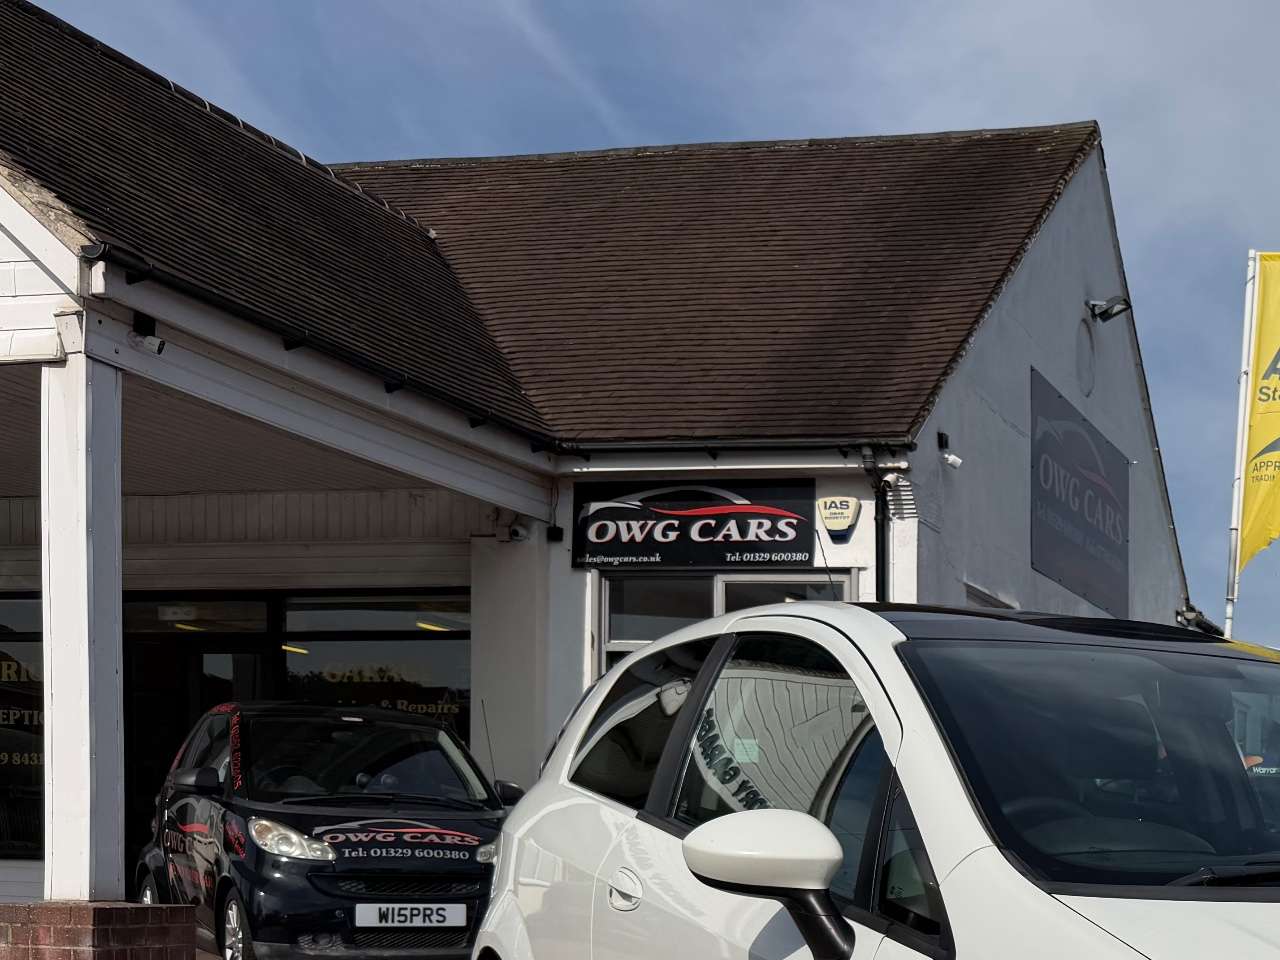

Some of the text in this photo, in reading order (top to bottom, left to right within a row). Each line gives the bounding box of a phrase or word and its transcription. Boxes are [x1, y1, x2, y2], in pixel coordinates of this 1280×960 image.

[824, 500, 850, 511] IAS
[1039, 453, 1079, 511] OWG
[1084, 488, 1123, 545] CARS
[587, 518, 798, 543] OWG CARS
[577, 553, 662, 566] les@owgcars.co.uk
[725, 552, 809, 562] Tel: 01329 600380
[395, 699, 461, 715] Repairs
[322, 833, 481, 846] OWG CARS
[342, 848, 470, 860] Tel: 01329 600380
